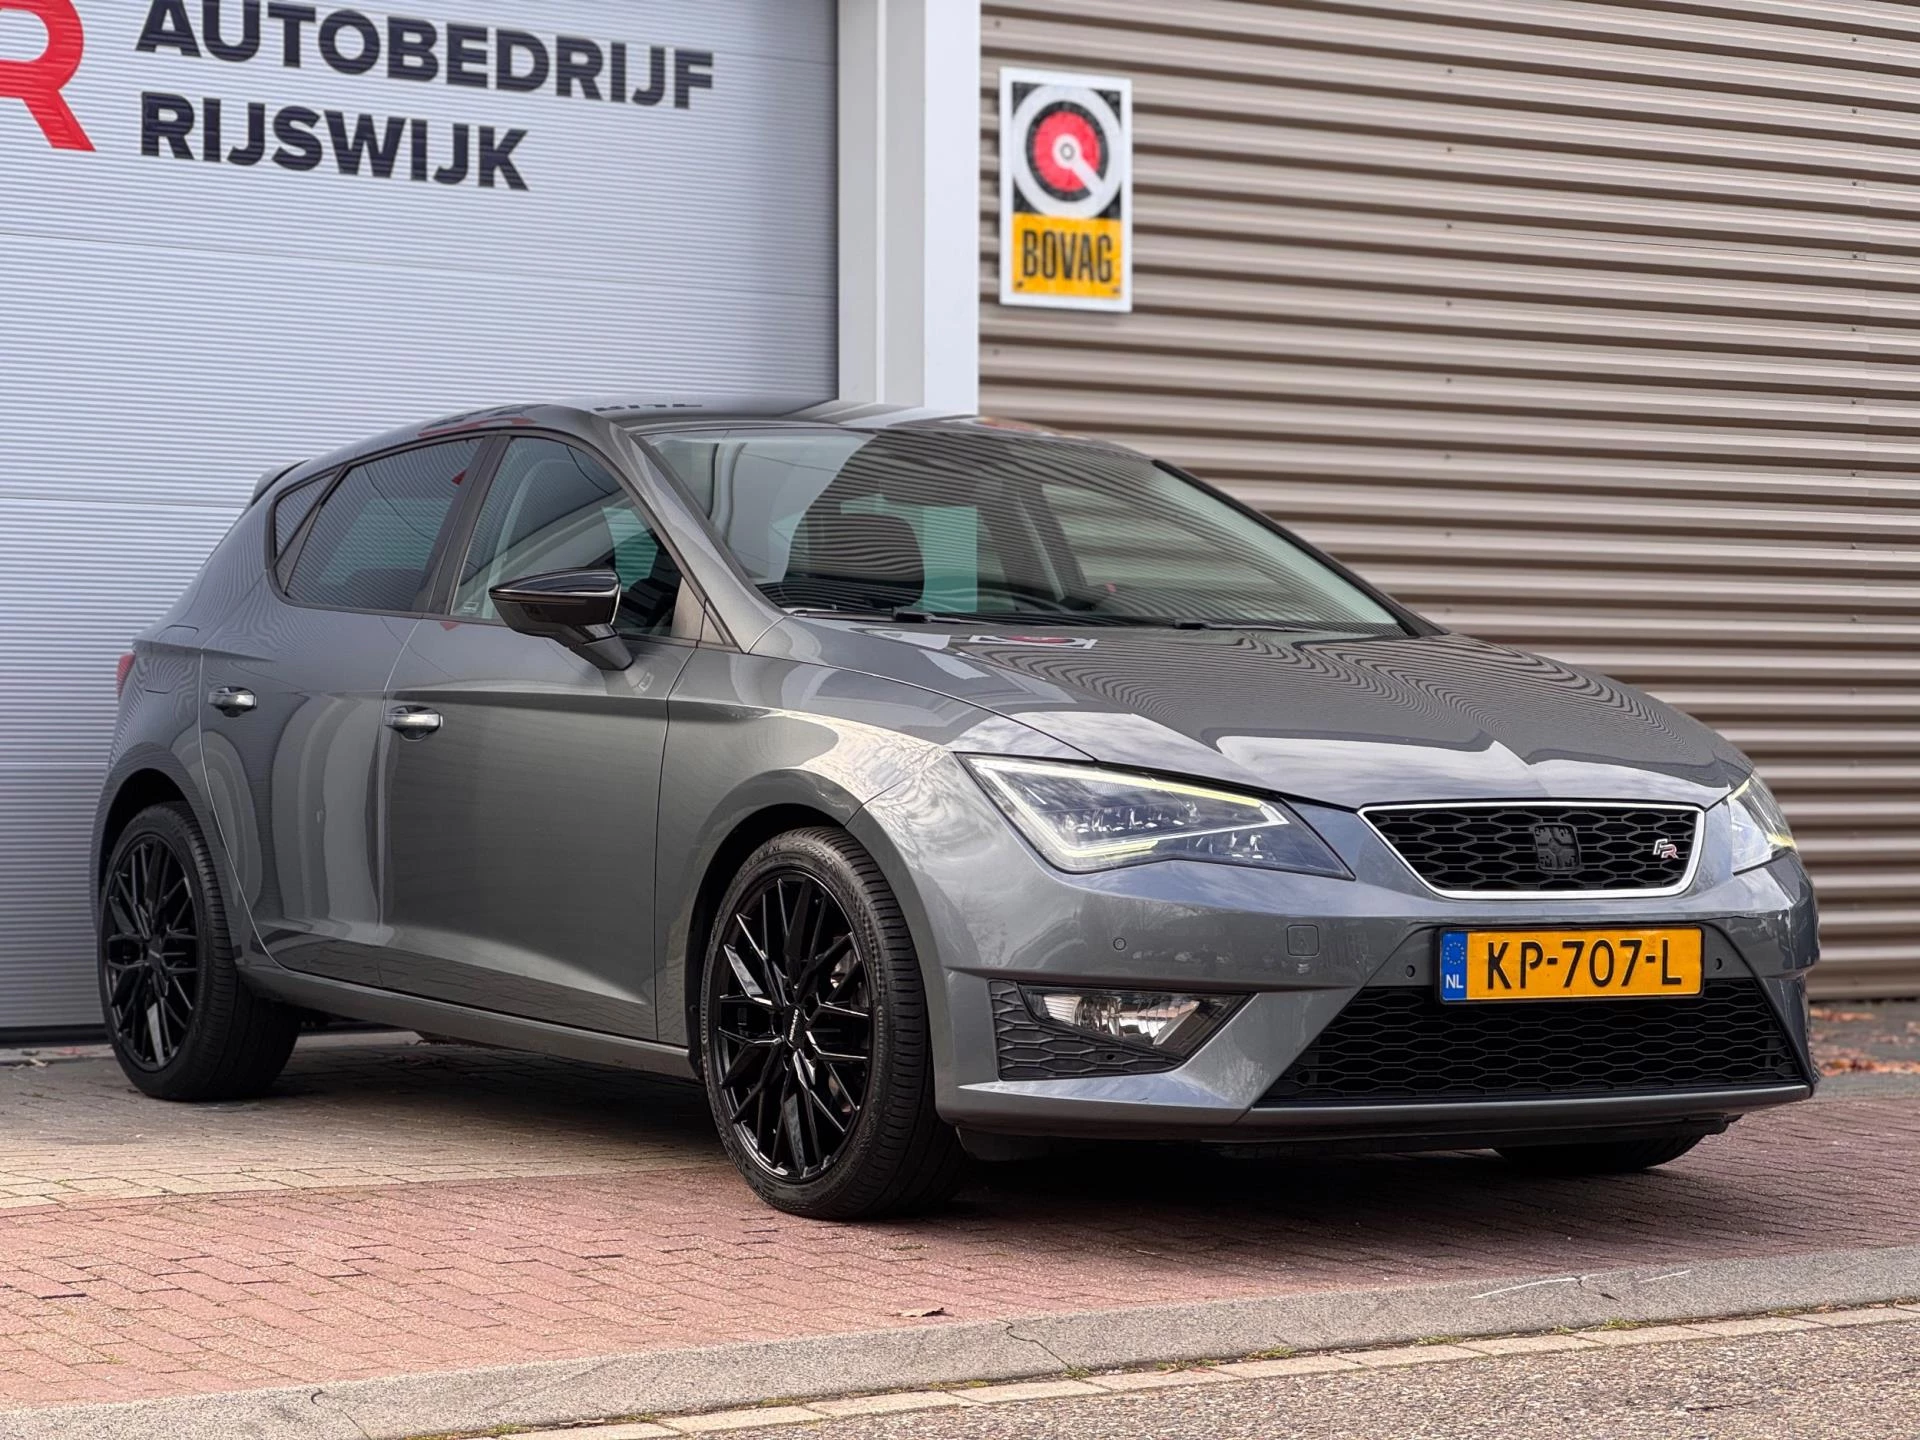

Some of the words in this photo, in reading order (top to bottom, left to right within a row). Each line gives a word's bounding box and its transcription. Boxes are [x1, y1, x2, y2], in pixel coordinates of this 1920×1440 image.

[136, 0, 713, 110] AUTOBEDRIJF
[141, 91, 529, 191] RIJSWIJK
[1021, 230, 1112, 283] BOVAG
[1653, 839, 1678, 858] FR
[1446, 974, 1464, 989] NL
[1487, 939, 1682, 990] KP-707-L
